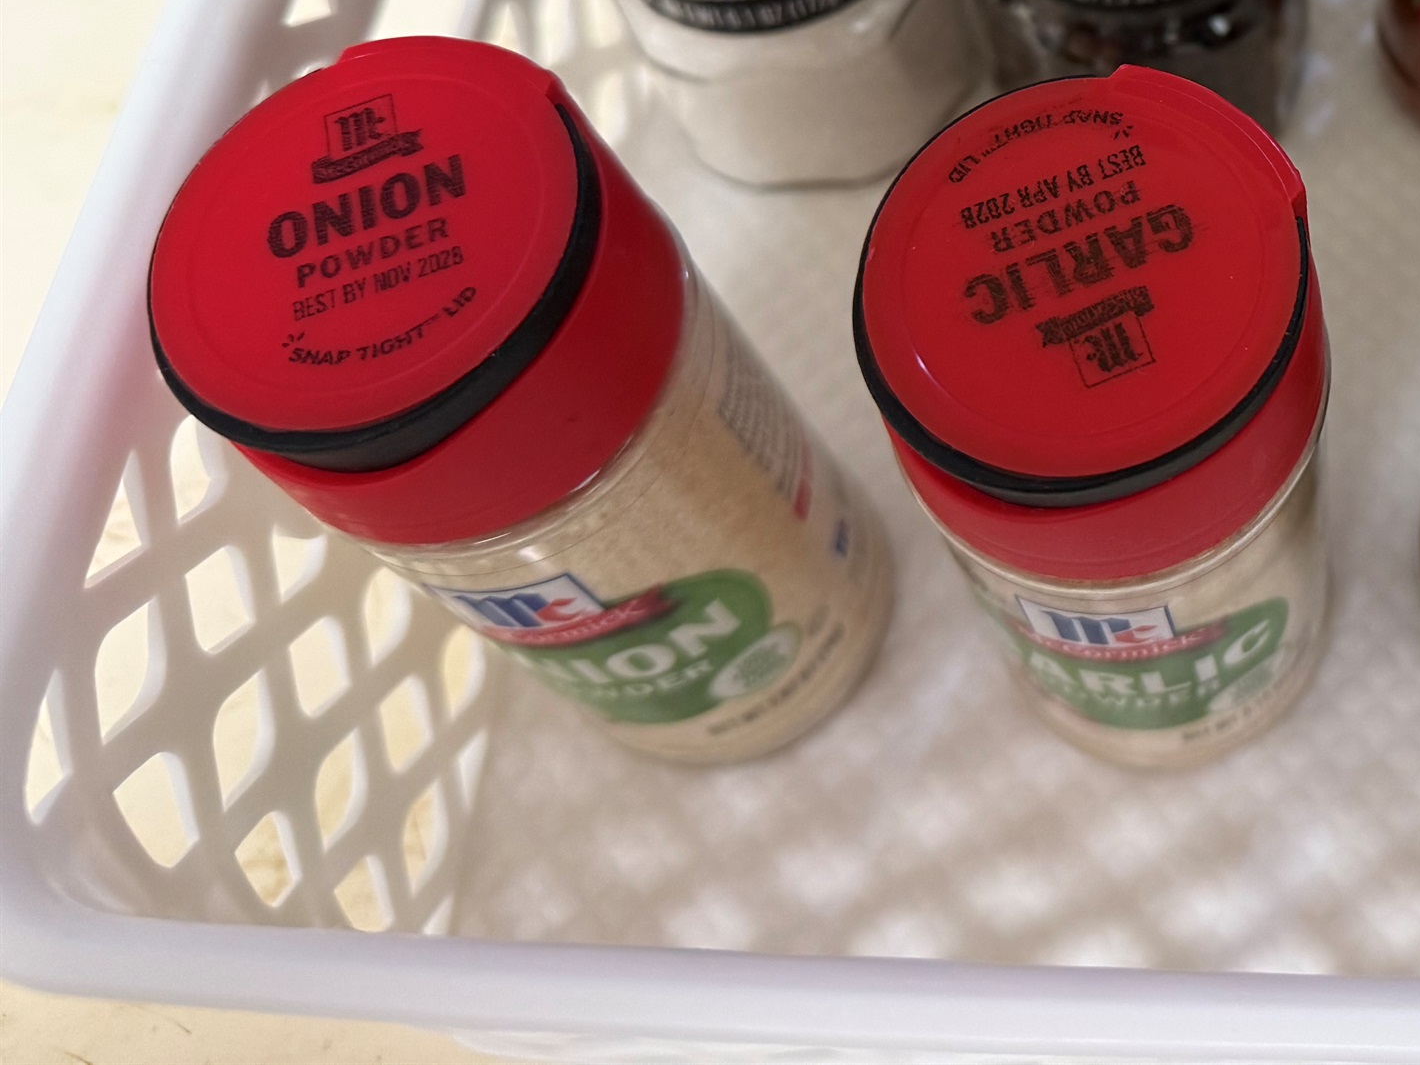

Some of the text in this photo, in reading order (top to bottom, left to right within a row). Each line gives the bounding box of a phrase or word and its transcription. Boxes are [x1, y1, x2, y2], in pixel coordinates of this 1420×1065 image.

[1062, 110, 1124, 125] SNAP
[948, 155, 981, 183] LID
[1017, 175, 1060, 208] APR
[1067, 164, 1094, 192] BY
[1098, 145, 1146, 180] BEST
[267, 154, 466, 259] ONION
[990, 180, 1142, 254] POWDER
[292, 246, 464, 321] BEST BY NOV 2028
[296, 217, 449, 288] POWDER
[962, 203, 1196, 325] GARLIC
[288, 347, 351, 365] SNAP
[443, 287, 477, 317] LID
[1029, 619, 1270, 694] ARLIC
